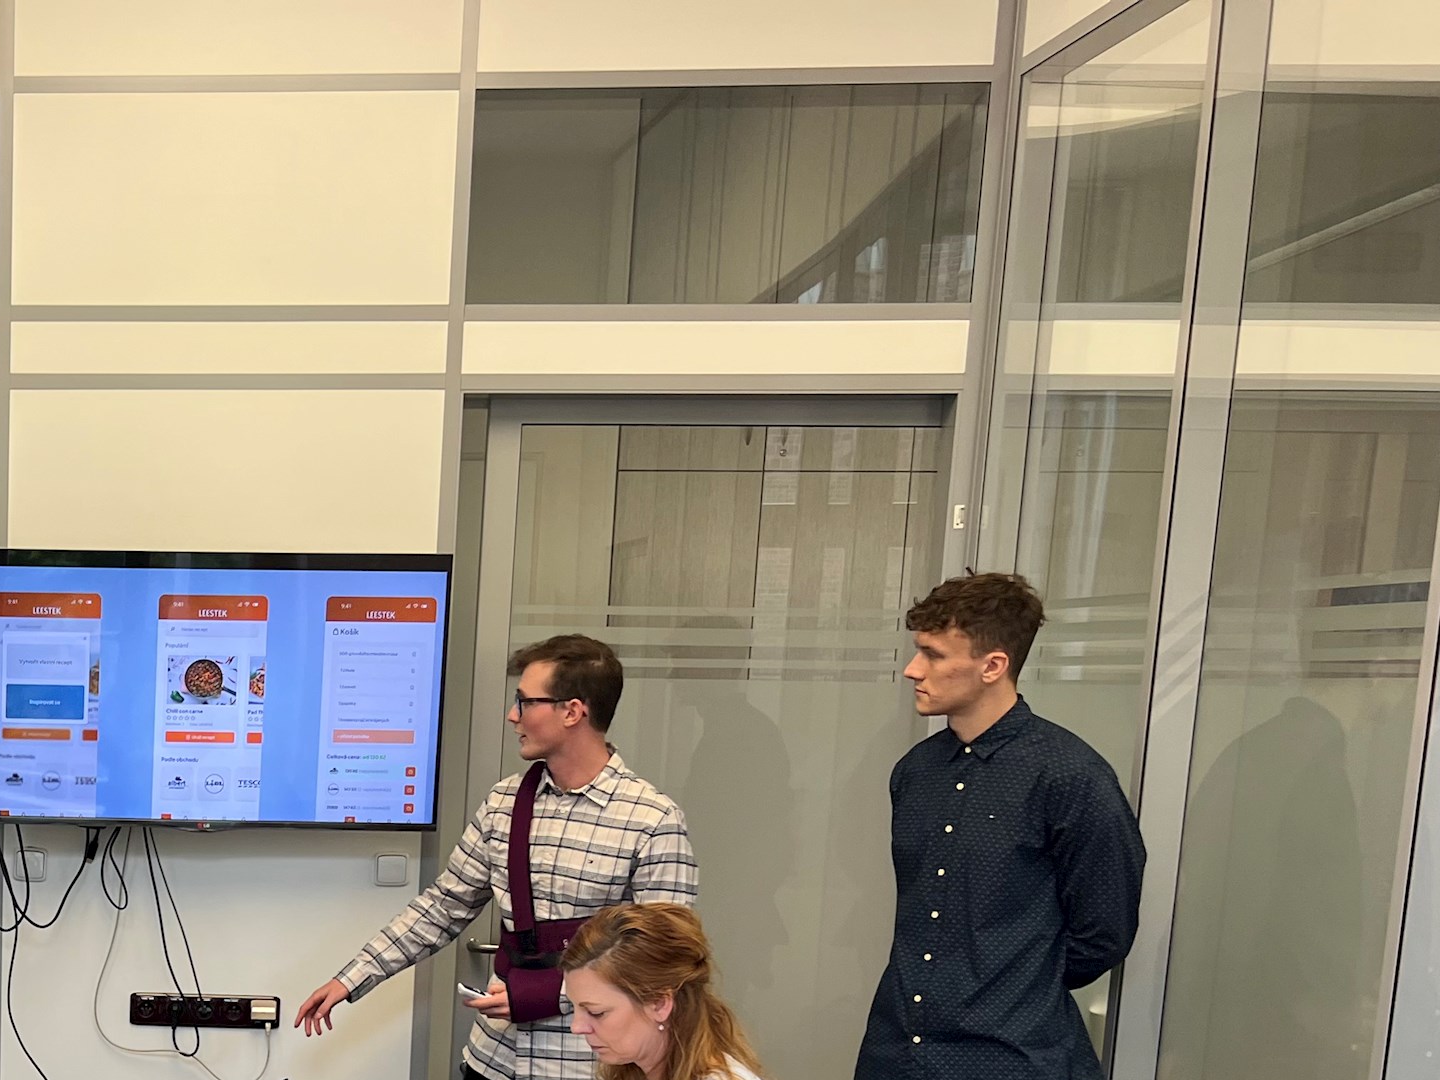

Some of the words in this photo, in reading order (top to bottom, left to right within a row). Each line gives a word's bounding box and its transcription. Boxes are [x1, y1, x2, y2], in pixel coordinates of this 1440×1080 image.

[32, 606, 62, 615] LEESTEK
[198, 609, 228, 618] LEESTEK
[366, 611, 396, 619] LEESTEK
